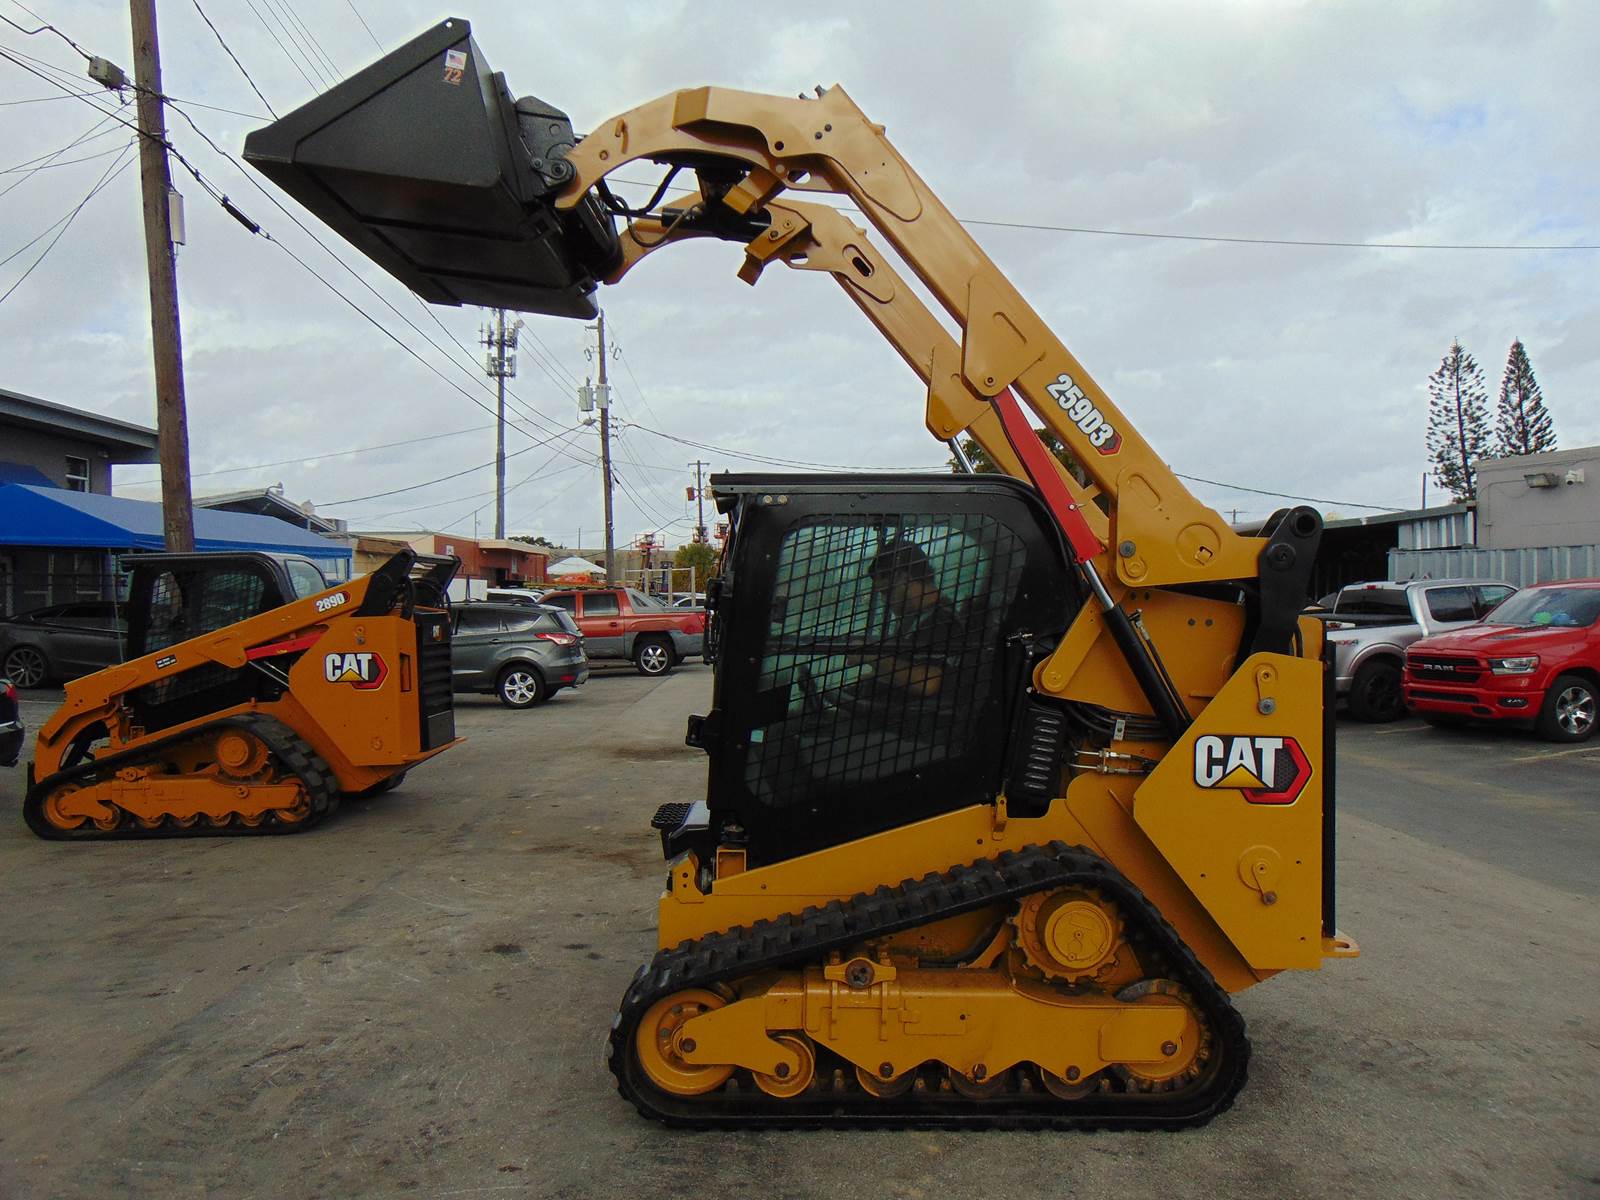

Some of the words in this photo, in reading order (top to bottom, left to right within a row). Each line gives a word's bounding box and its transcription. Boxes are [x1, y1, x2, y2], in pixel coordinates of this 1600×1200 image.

[444, 67, 463, 82] 72
[1045, 373, 1114, 447] 259D3
[325, 652, 373, 682] CAT
[1195, 735, 1283, 789] CAT
